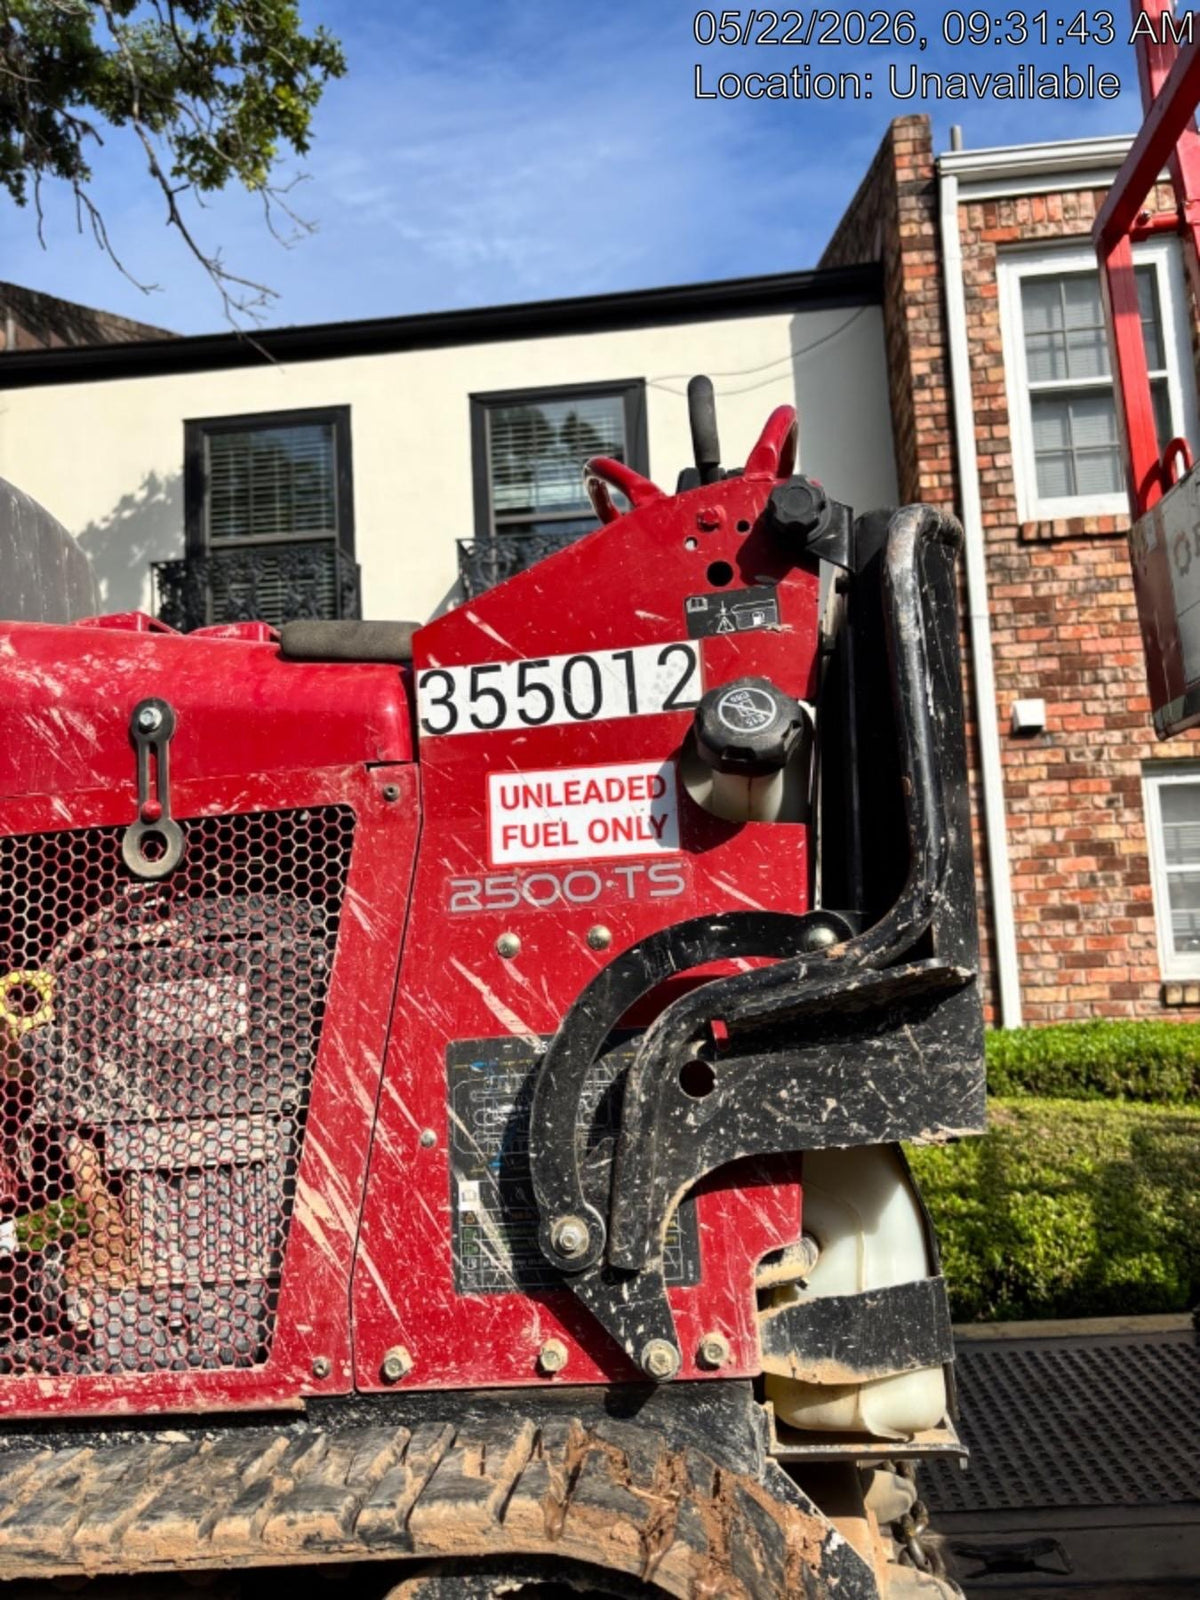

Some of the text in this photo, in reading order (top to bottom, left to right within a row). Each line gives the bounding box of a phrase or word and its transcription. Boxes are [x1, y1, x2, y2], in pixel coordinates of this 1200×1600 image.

[419, 643, 698, 735] 355012
[500, 774, 667, 810] UNLEADED
[502, 813, 669, 850] FUEL ONLY
